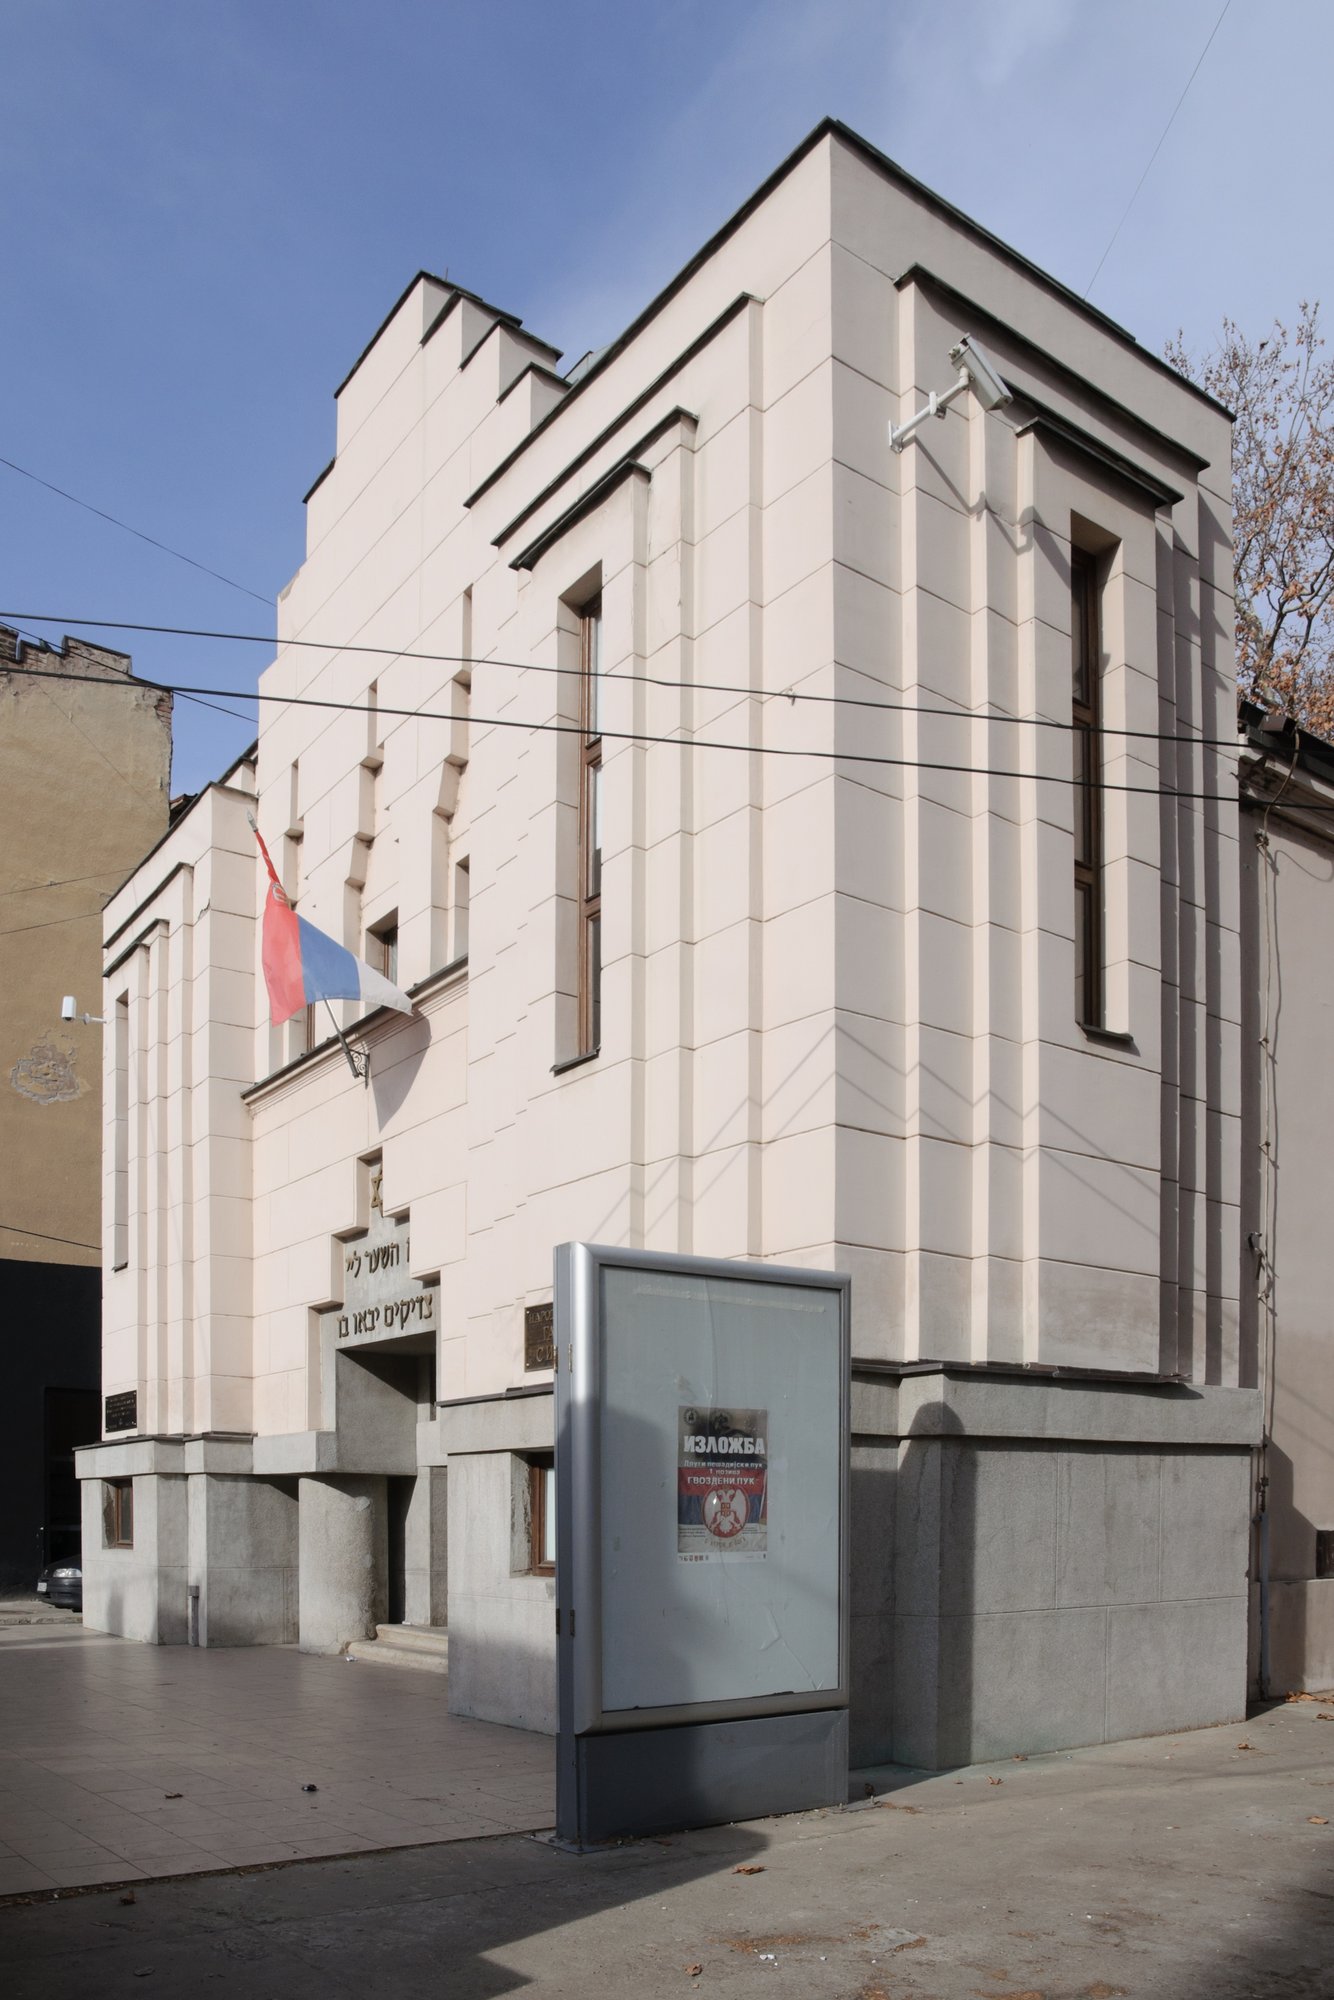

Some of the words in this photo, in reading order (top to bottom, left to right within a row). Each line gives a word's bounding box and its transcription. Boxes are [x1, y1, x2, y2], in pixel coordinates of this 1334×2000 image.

[364, 1242, 400, 1274] השער
[352, 1306, 381, 1335] יבאו
[384, 1294, 433, 1330] צדיקים
[528, 1310, 553, 1323] НАРО
[337, 1315, 349, 1339] בו
[683, 1435, 766, 1455] ИЗЛОЖБА
[687, 1476, 736, 1486] ГВОЗДЕНИ
[737, 1477, 755, 1486] ПУК
